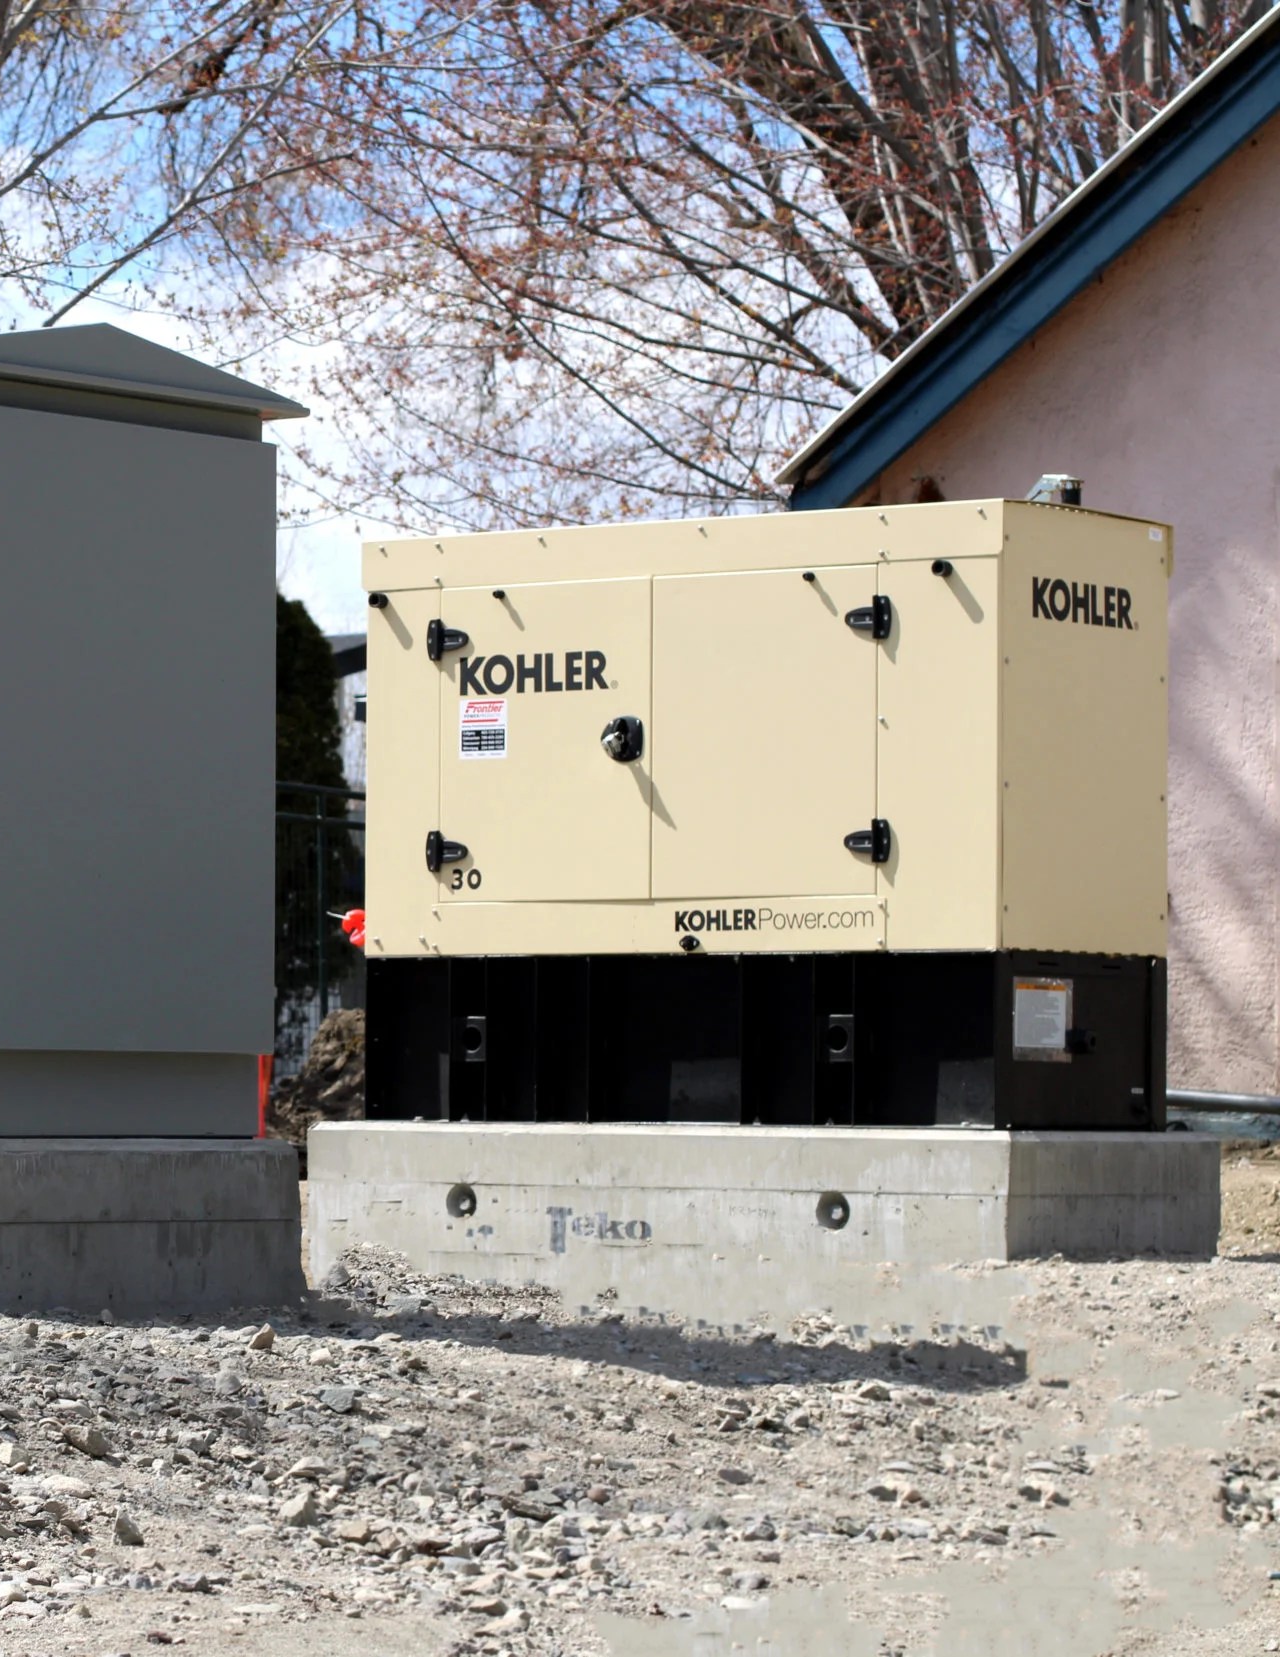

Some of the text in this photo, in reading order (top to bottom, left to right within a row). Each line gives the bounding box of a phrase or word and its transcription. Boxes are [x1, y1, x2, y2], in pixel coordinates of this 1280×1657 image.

[1032, 576, 1133, 630] KOHLER
[459, 651, 609, 696] KOHLER
[451, 868, 482, 890] 30
[675, 908, 874, 932] KOHLERPower.com
[546, 1206, 652, 1254] Teko
